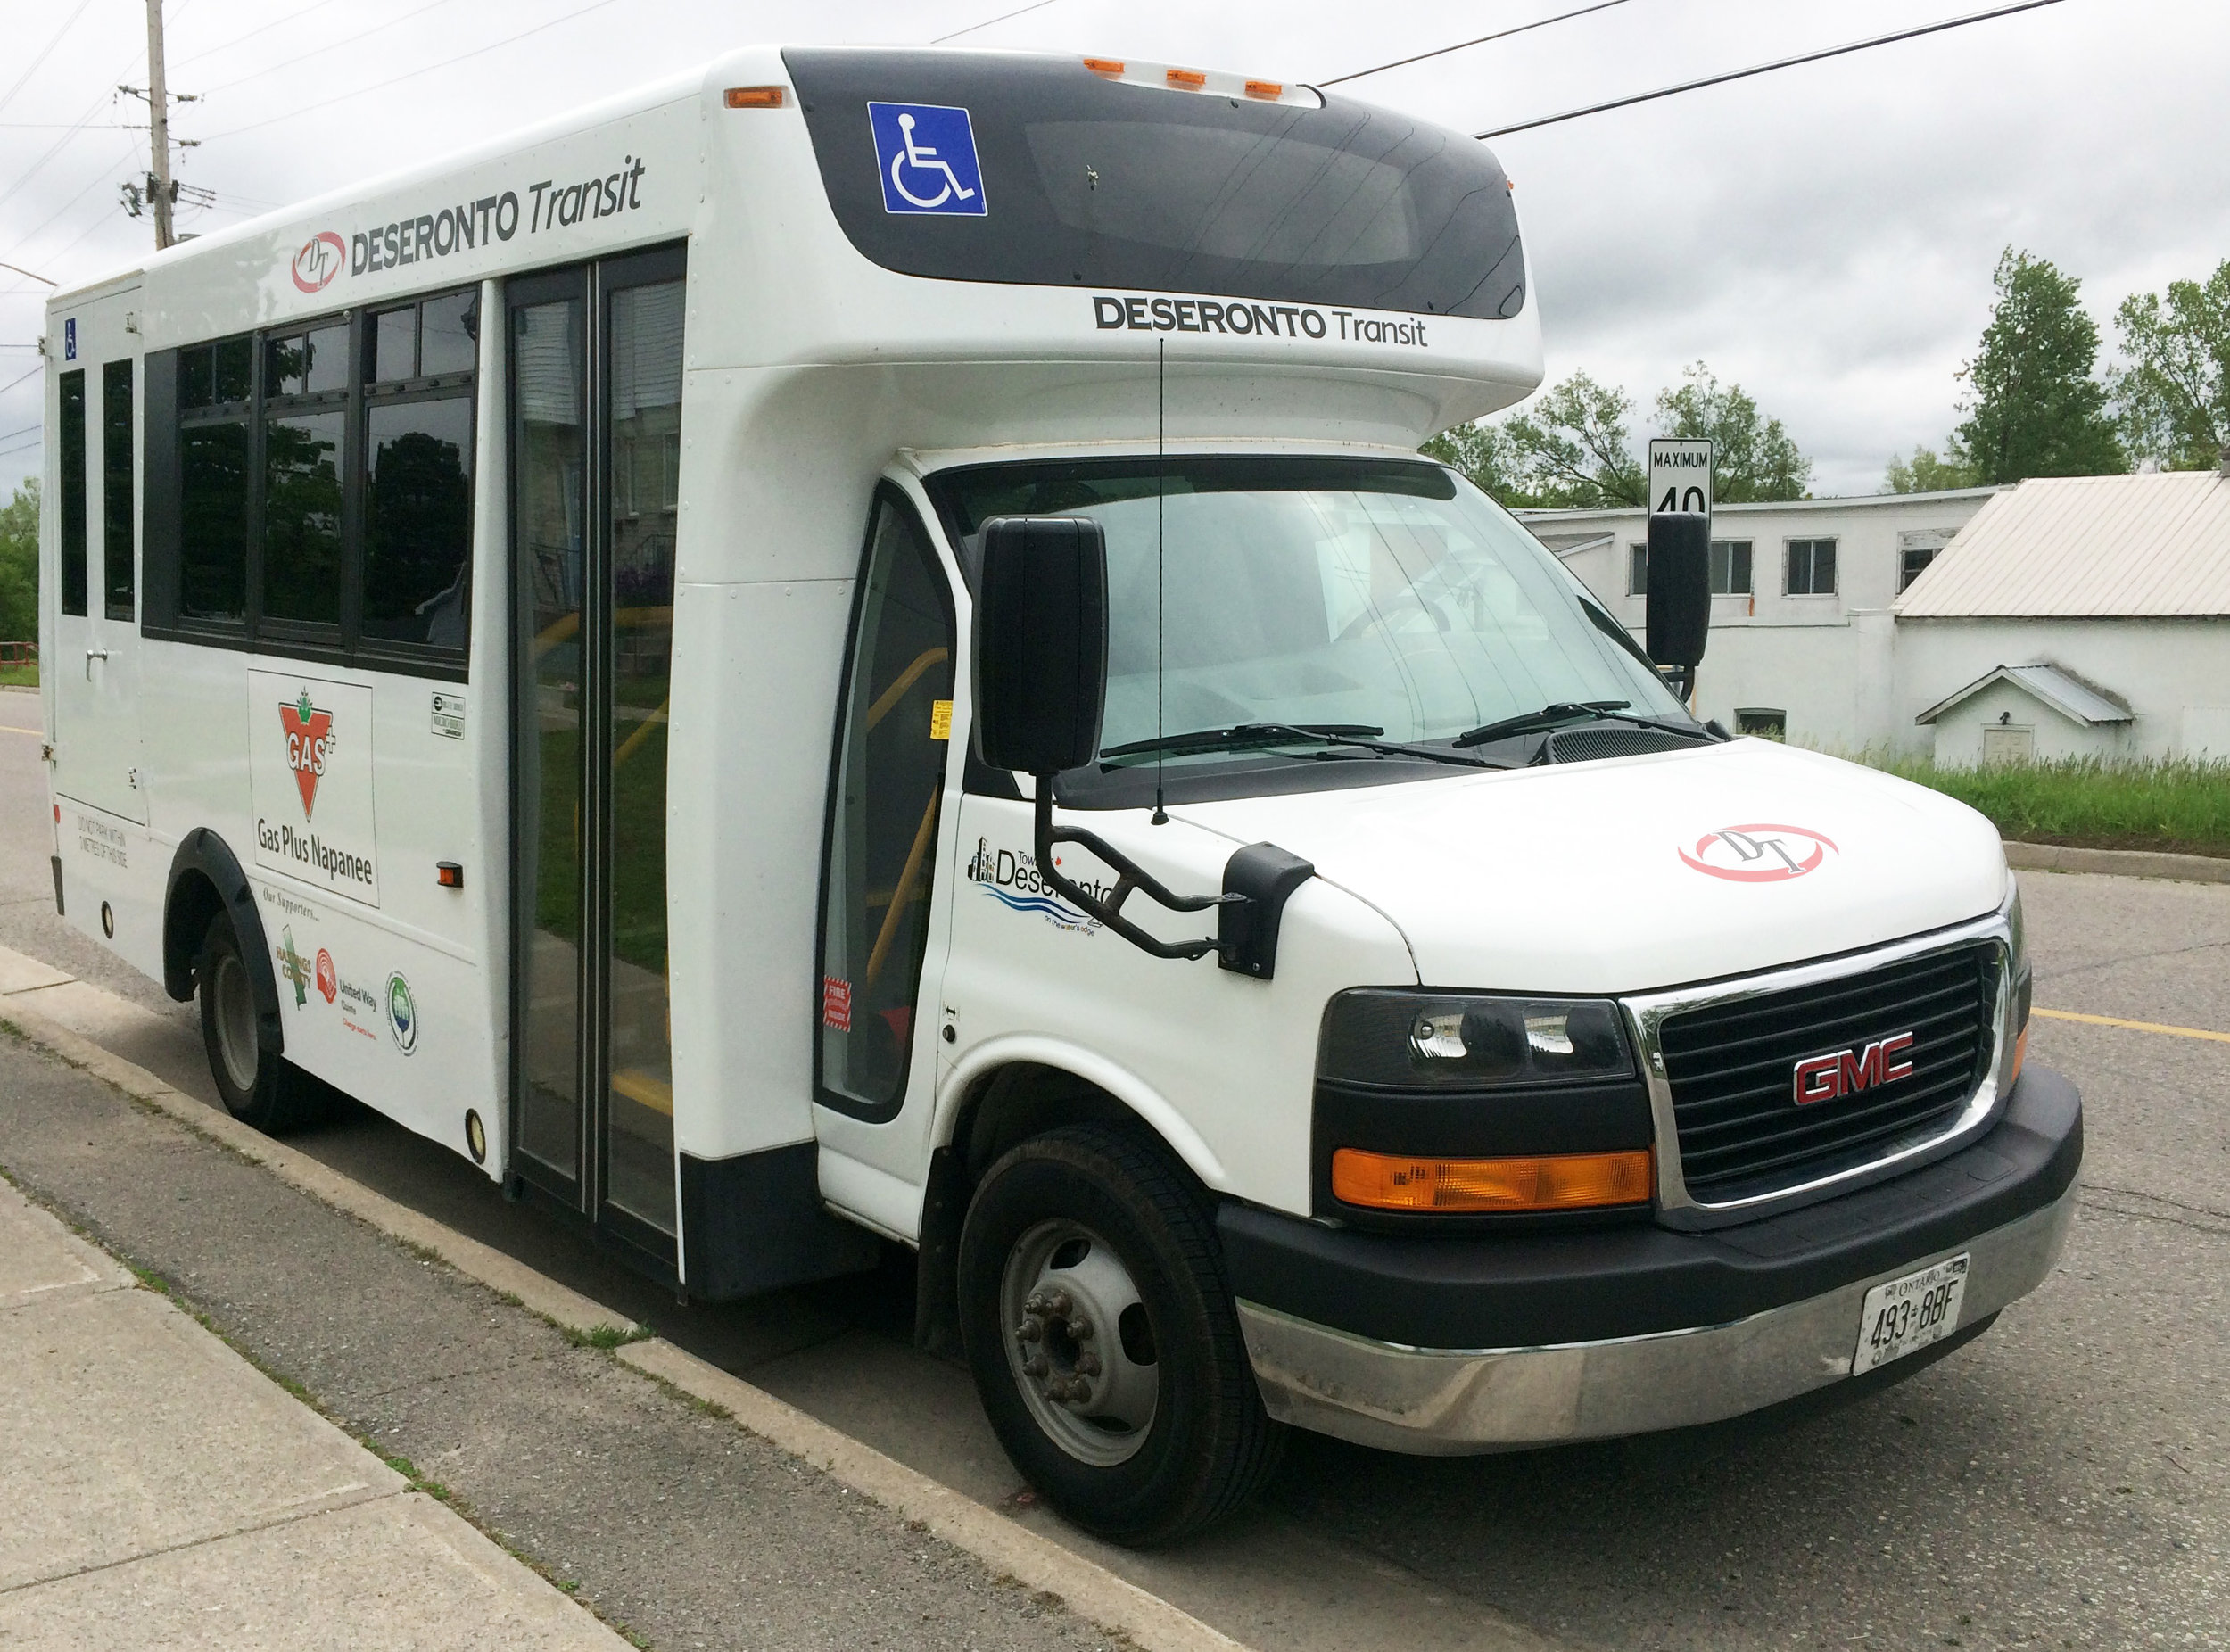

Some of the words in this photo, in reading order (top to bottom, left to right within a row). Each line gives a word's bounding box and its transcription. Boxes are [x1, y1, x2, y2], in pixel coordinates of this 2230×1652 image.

[351, 191, 519, 277] DESERONTO
[529, 154, 645, 234] Transit
[1093, 296, 1326, 338] DESERONTO
[1332, 310, 1429, 347] Transit
[1654, 451, 1708, 468] MAXIMUM
[1656, 486, 1706, 513] 40
[258, 818, 280, 854] Gas
[282, 824, 310, 863] Plus
[311, 834, 373, 885] Napanee
[1018, 850, 1037, 866] Tow
[995, 849, 1113, 903] Desent
[339, 979, 361, 1001] United
[361, 988, 376, 1012] Way
[829, 985, 846, 1000] FIRE
[1794, 1031, 1913, 1105] GMC
